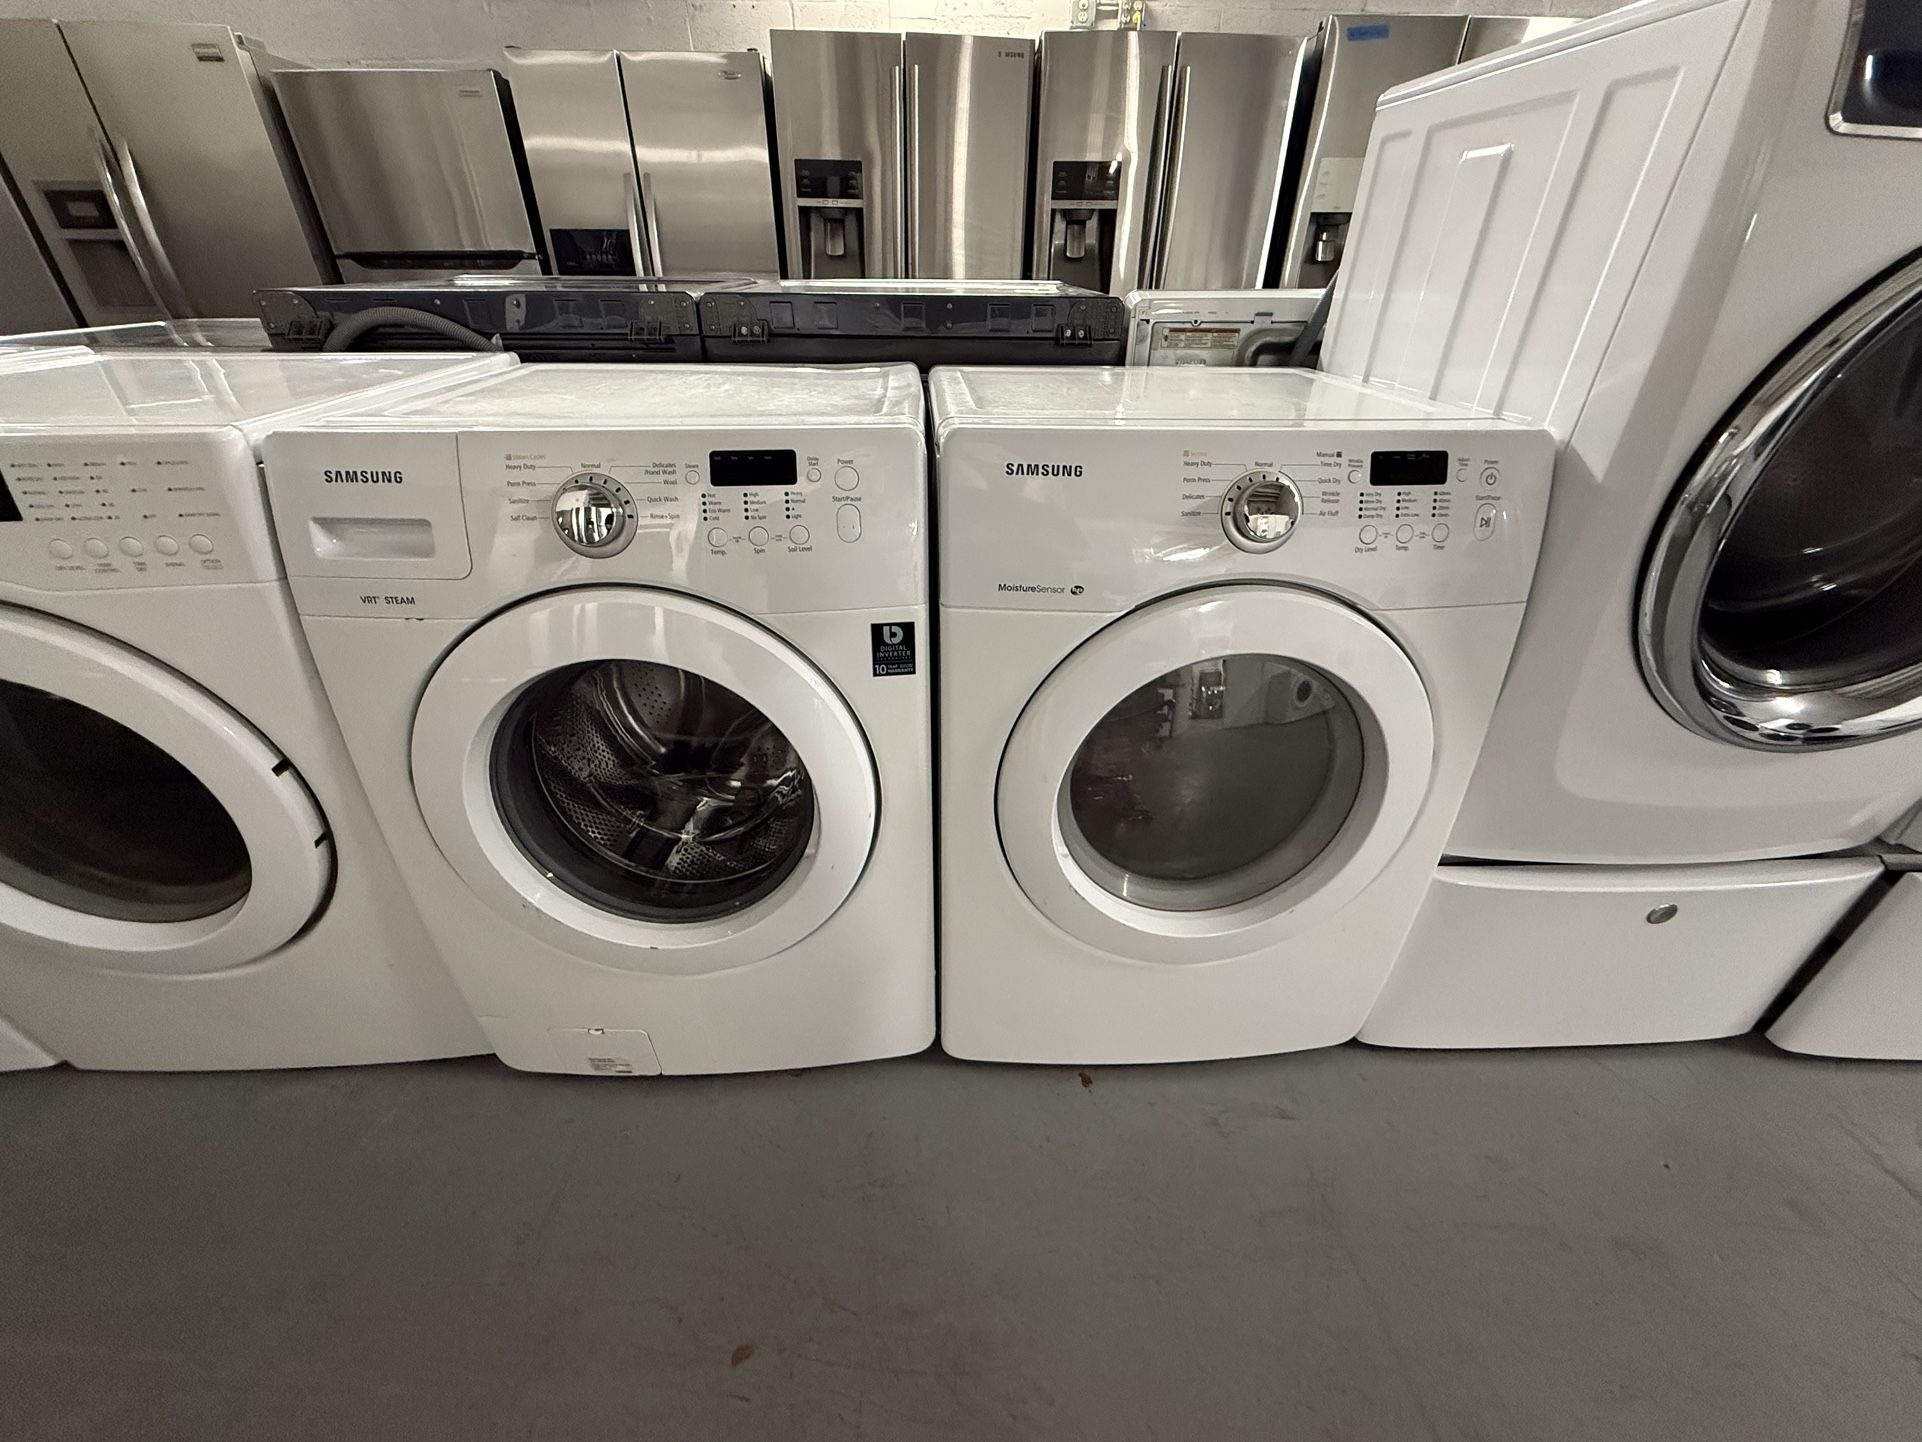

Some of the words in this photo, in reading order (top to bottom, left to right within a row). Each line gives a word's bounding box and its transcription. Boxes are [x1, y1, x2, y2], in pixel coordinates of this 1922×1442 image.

[505, 463, 522, 472] Heavy
[523, 463, 536, 471] Duty
[1200, 460, 1212, 468] Duty
[1005, 462, 1084, 477] SAMSUNG
[324, 470, 403, 484] SAMSUNG
[832, 495, 862, 503] Start/Pause
[998, 583, 1065, 594] MoistureSensor
[384, 596, 416, 605] STEAM
[876, 650, 911, 658] INVERTER
[875, 664, 887, 675] 10
